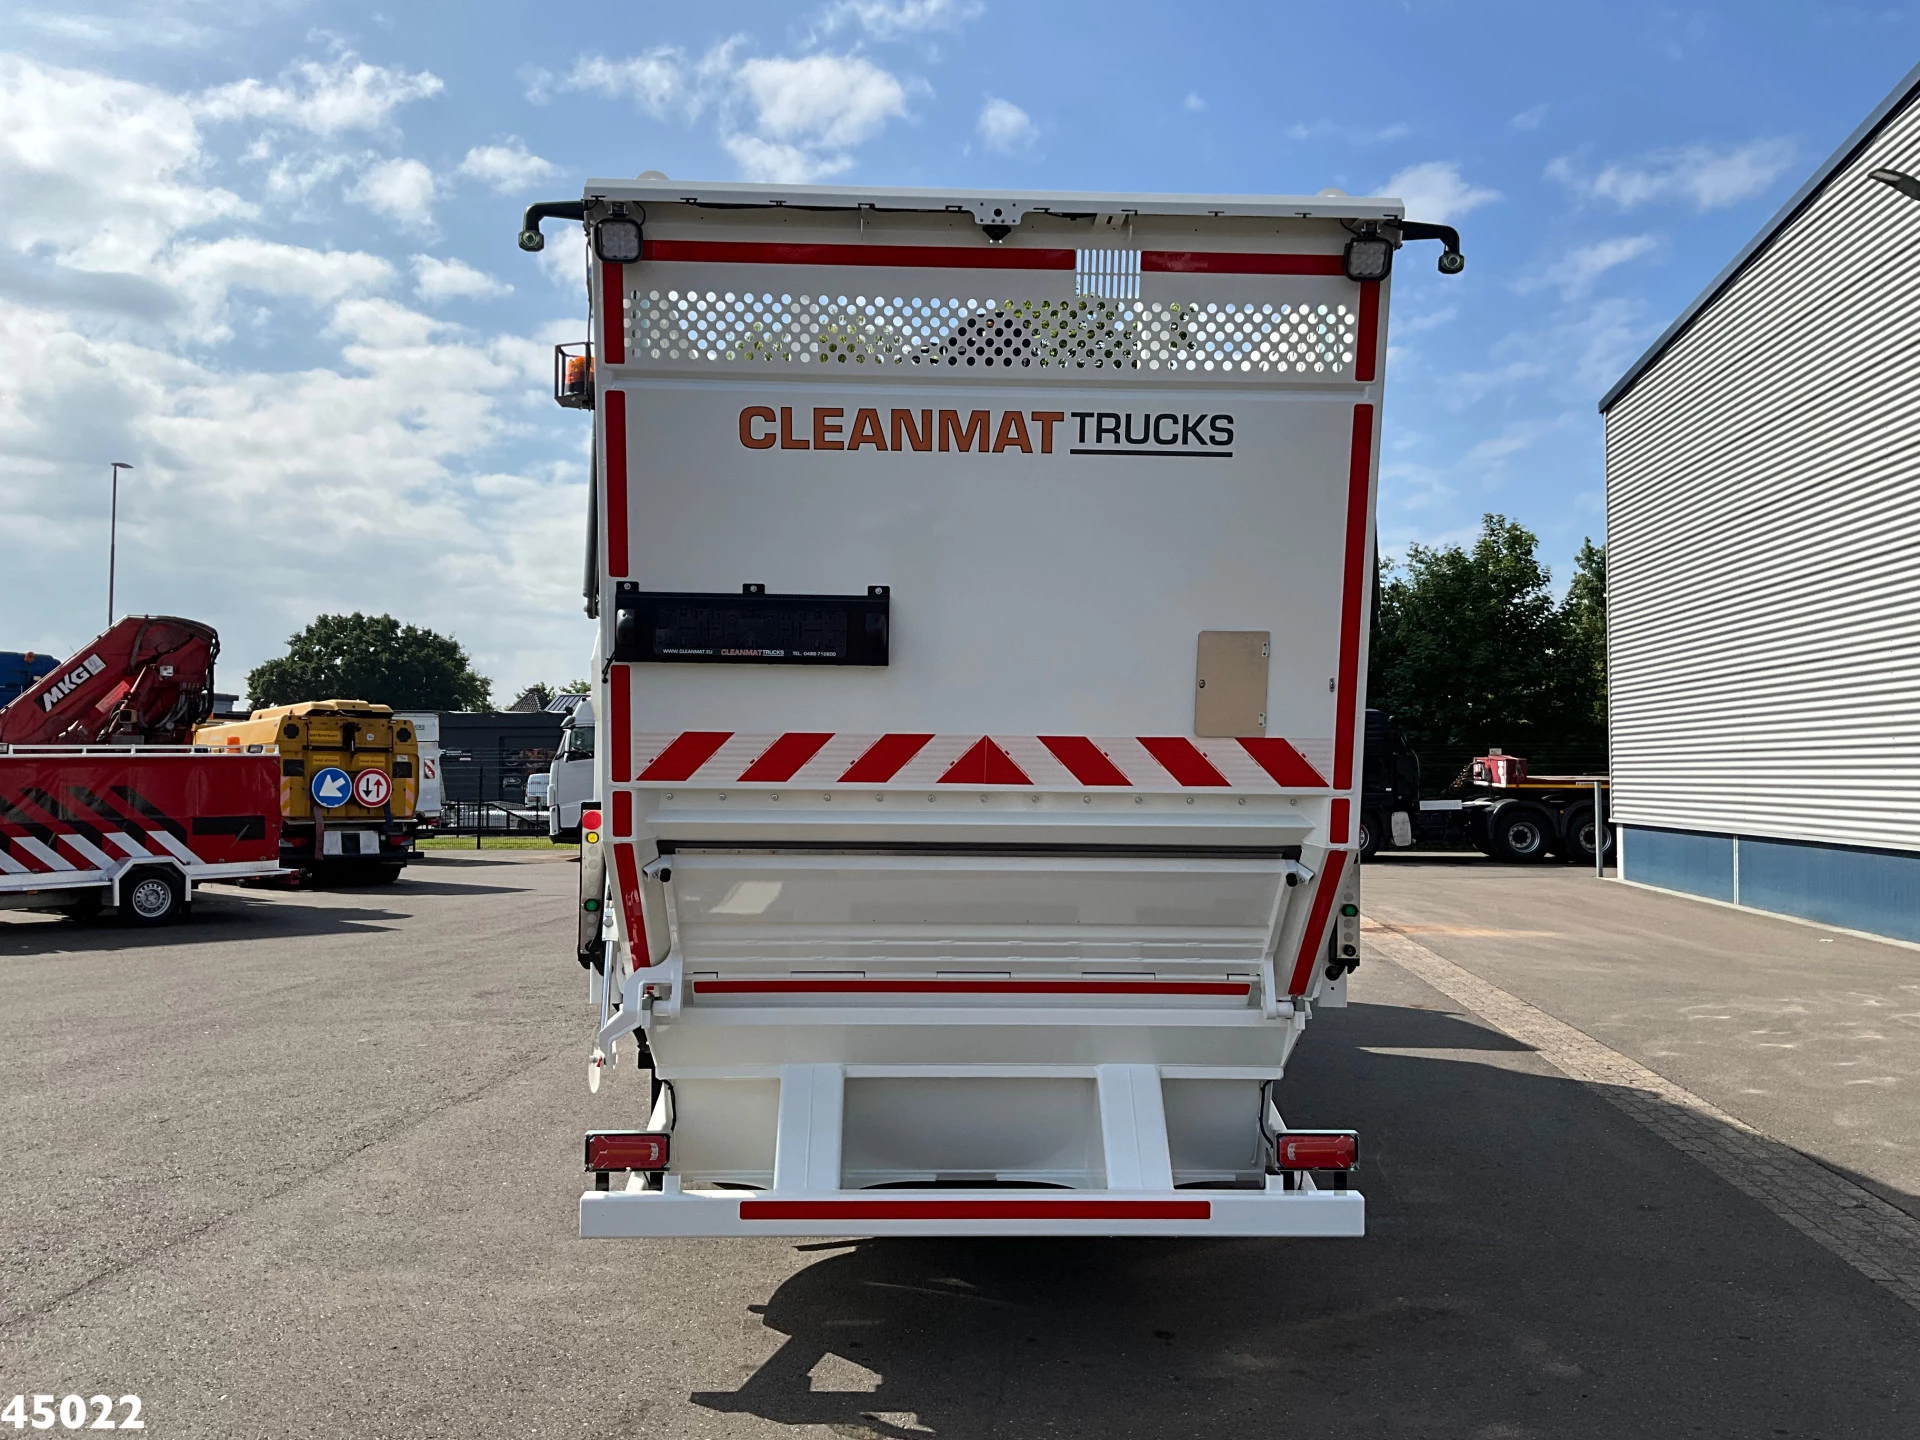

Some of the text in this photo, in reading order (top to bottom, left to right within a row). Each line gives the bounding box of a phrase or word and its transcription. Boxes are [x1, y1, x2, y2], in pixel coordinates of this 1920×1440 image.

[738, 406, 1234, 454] CLEANMAT TRUCKS
[42, 666, 90, 712] MKG
